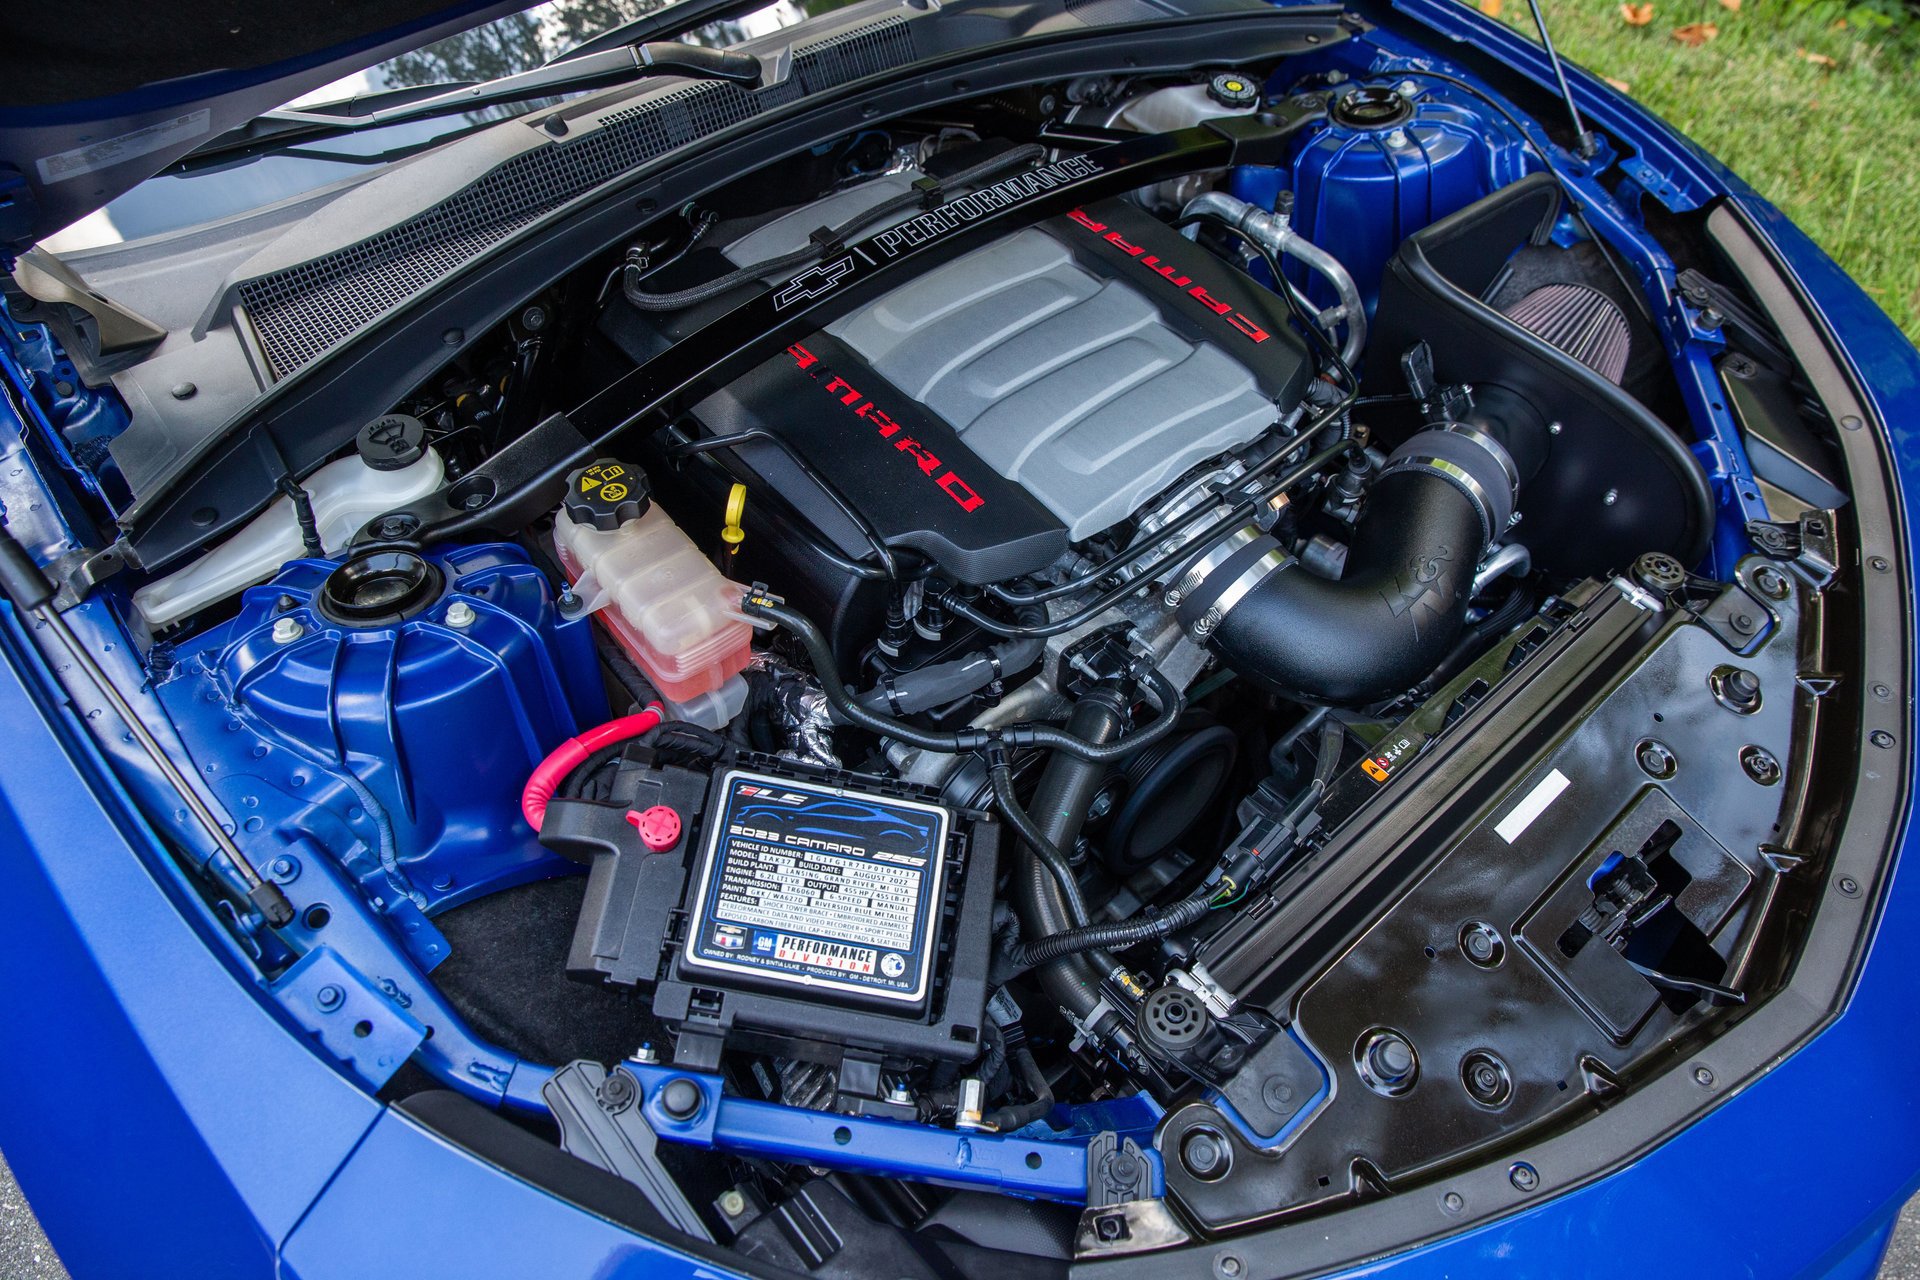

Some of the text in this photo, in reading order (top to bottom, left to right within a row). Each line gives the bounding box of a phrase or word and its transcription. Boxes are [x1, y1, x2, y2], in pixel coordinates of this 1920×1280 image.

[872, 154, 1104, 258] PERFORMANCE
[736, 785, 808, 805] 1LE
[729, 824, 779, 841] 2023
[784, 834, 865, 856] CAMARO
[730, 840, 759, 850] VEHICLE
[769, 846, 803, 858] NUMBER:
[725, 866, 754, 876] ENGINE:
[759, 872, 774, 880] 6.2L
[806, 880, 838, 891] OUTPUT:
[727, 857, 749, 866] BUILD
[750, 861, 774, 871] PLANT:
[785, 868, 821, 880] LANSING,
[824, 875, 850, 884] GRAND
[852, 880, 877, 890] RIVER,
[729, 848, 757, 859] MODEL:
[798, 860, 820, 870] BUILD
[820, 864, 841, 873] DATE:
[853, 870, 885, 881] AUGUST
[889, 877, 908, 885] 2022
[721, 883, 745, 893] PAINT:
[814, 900, 851, 912] RIVERSIDE
[854, 907, 871, 915] BLUE
[874, 910, 908, 921] METALLIC
[723, 874, 908, 912] TRANSMISSION: TR6060 6-SPEED MANUAL
[720, 892, 908, 929] FEATURES: SHOCK TOWER BRACE EMBROIDERED ARMREST
[722, 902, 769, 915] PERFORMANCE
[804, 916, 824, 924] VIDEO
[826, 920, 859, 930] RECORDER
[864, 926, 884, 935] SPORT
[886, 930, 909, 939] PEDALS
[720, 911, 747, 921] EXPOSED
[748, 916, 773, 925] CARBON
[854, 934, 868, 942] PADS
[891, 940, 908, 948] BELTS
[757, 936, 772, 948] GM
[703, 948, 724, 956] OWNED
[736, 954, 759, 962] RODNEY
[806, 966, 837, 976] PRODUCED
[778, 949, 870, 972] DIVISION
[781, 936, 872, 962] PERFORMANCE
